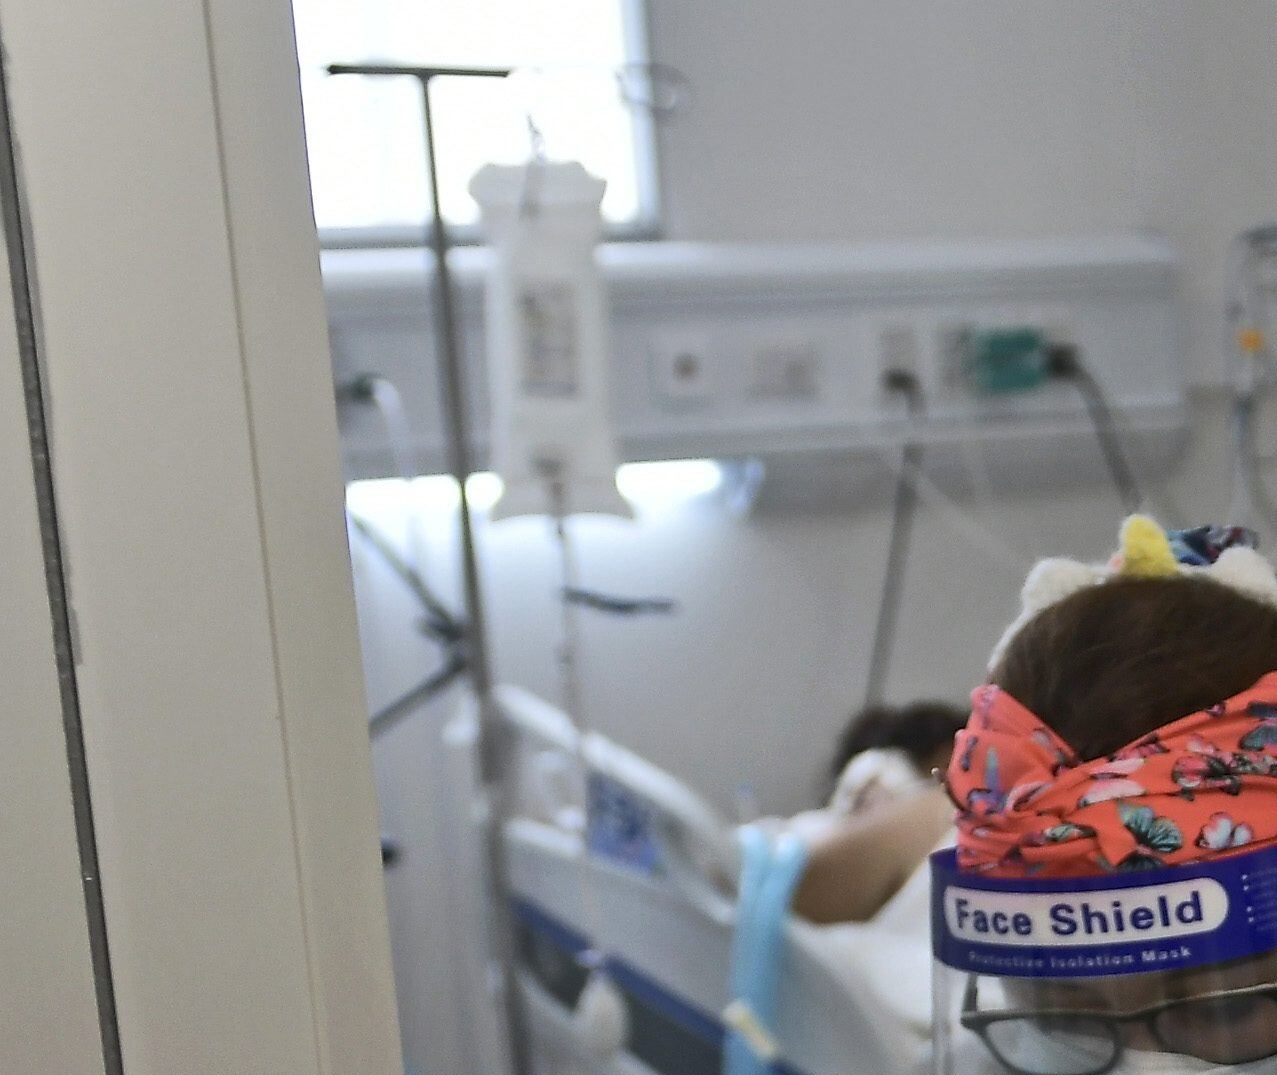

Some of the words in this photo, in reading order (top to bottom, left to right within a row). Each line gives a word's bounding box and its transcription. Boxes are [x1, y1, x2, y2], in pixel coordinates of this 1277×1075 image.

[954, 897, 1032, 936] Face
[1050, 890, 1204, 936] Shield
[1142, 945, 1192, 963] Mask
